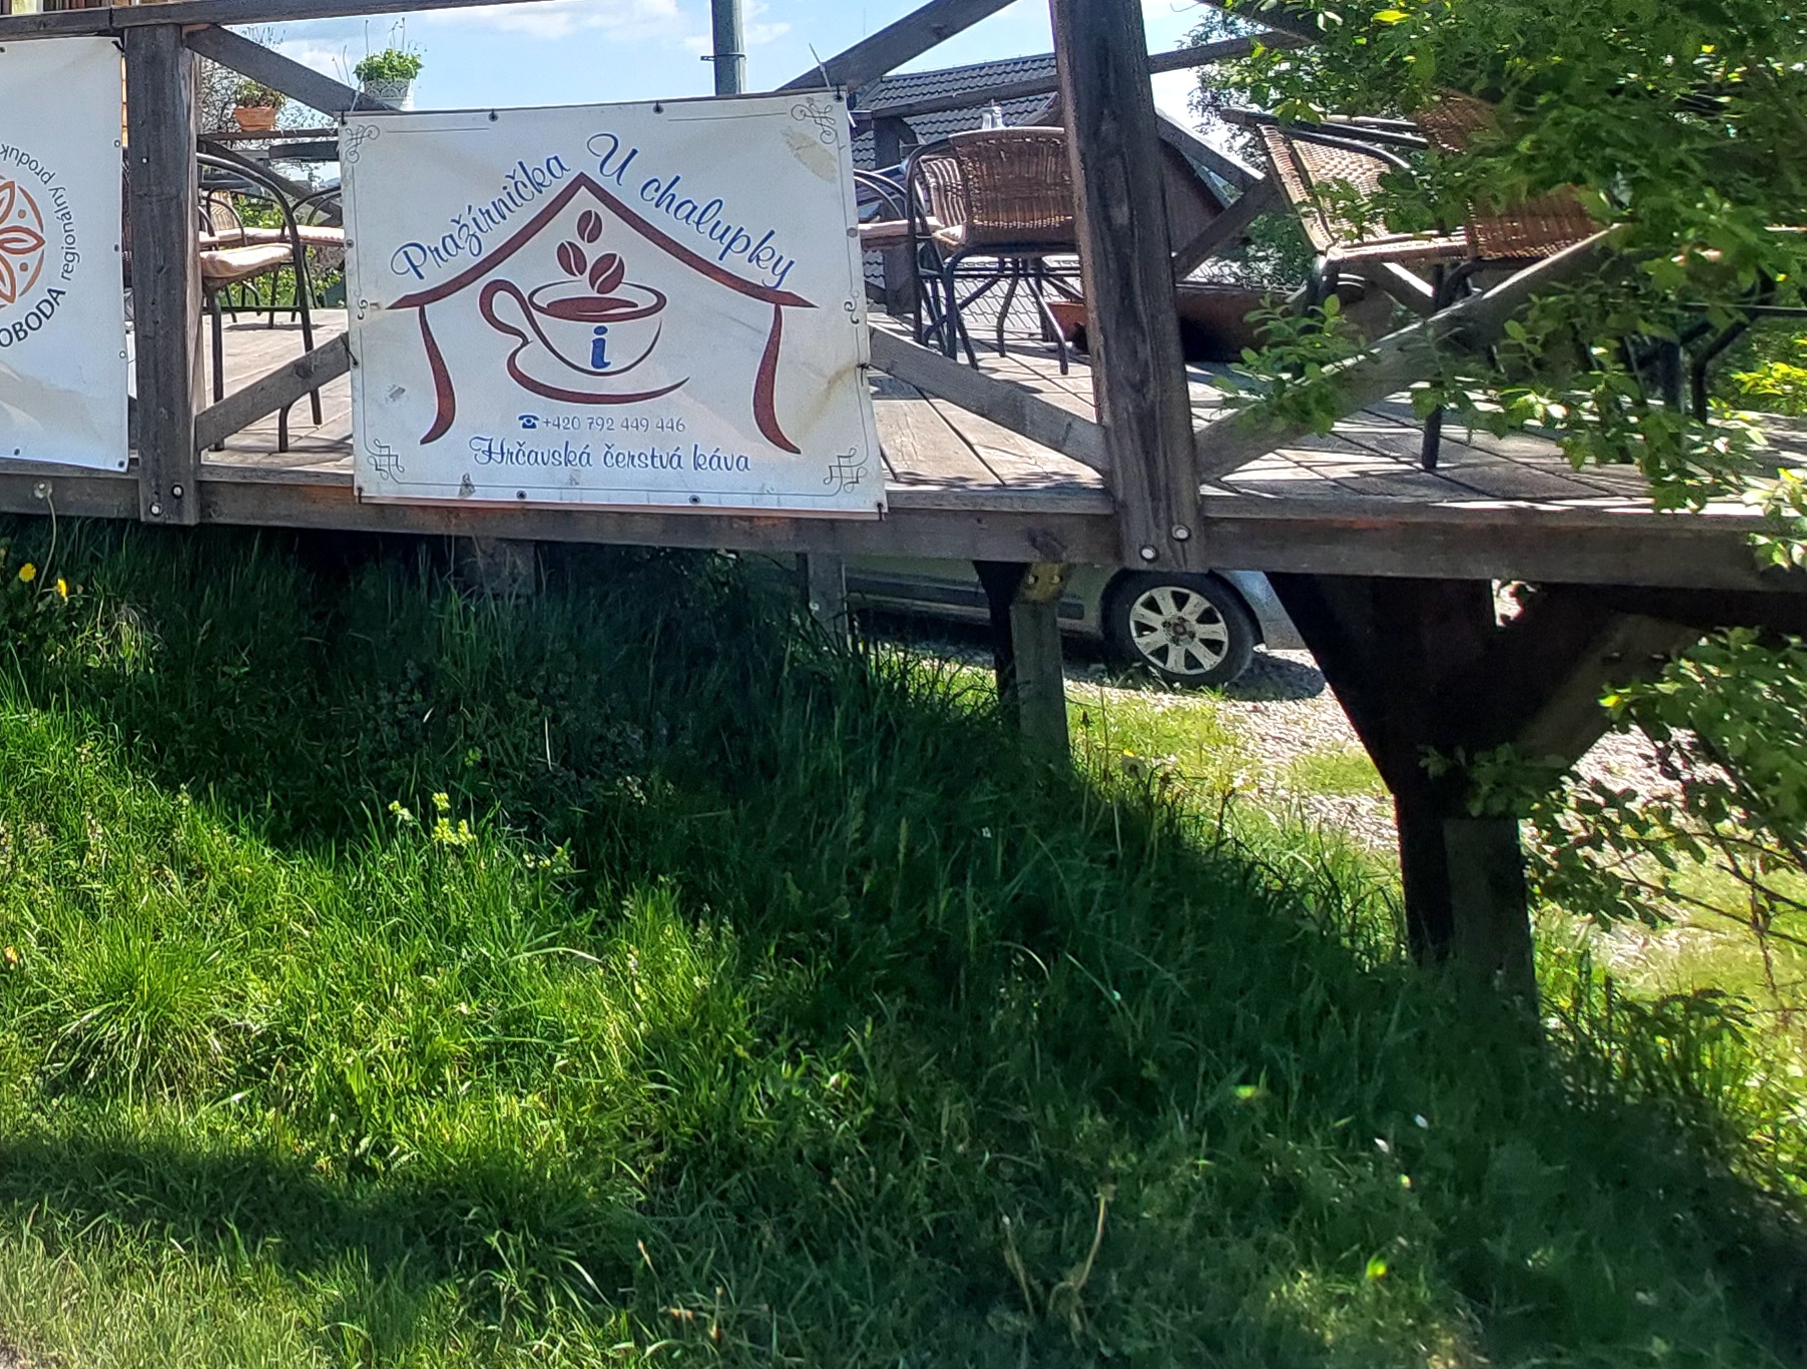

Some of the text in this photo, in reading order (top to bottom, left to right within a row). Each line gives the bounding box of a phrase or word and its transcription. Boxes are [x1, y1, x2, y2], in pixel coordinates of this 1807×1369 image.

[48, 186, 80, 281] regionálny
[390, 133, 795, 290] Pražírnička U chalupky
[469, 436, 751, 471] Hrčavská čerstvá káva
[543, 416, 686, 433] +420 792 449 446
